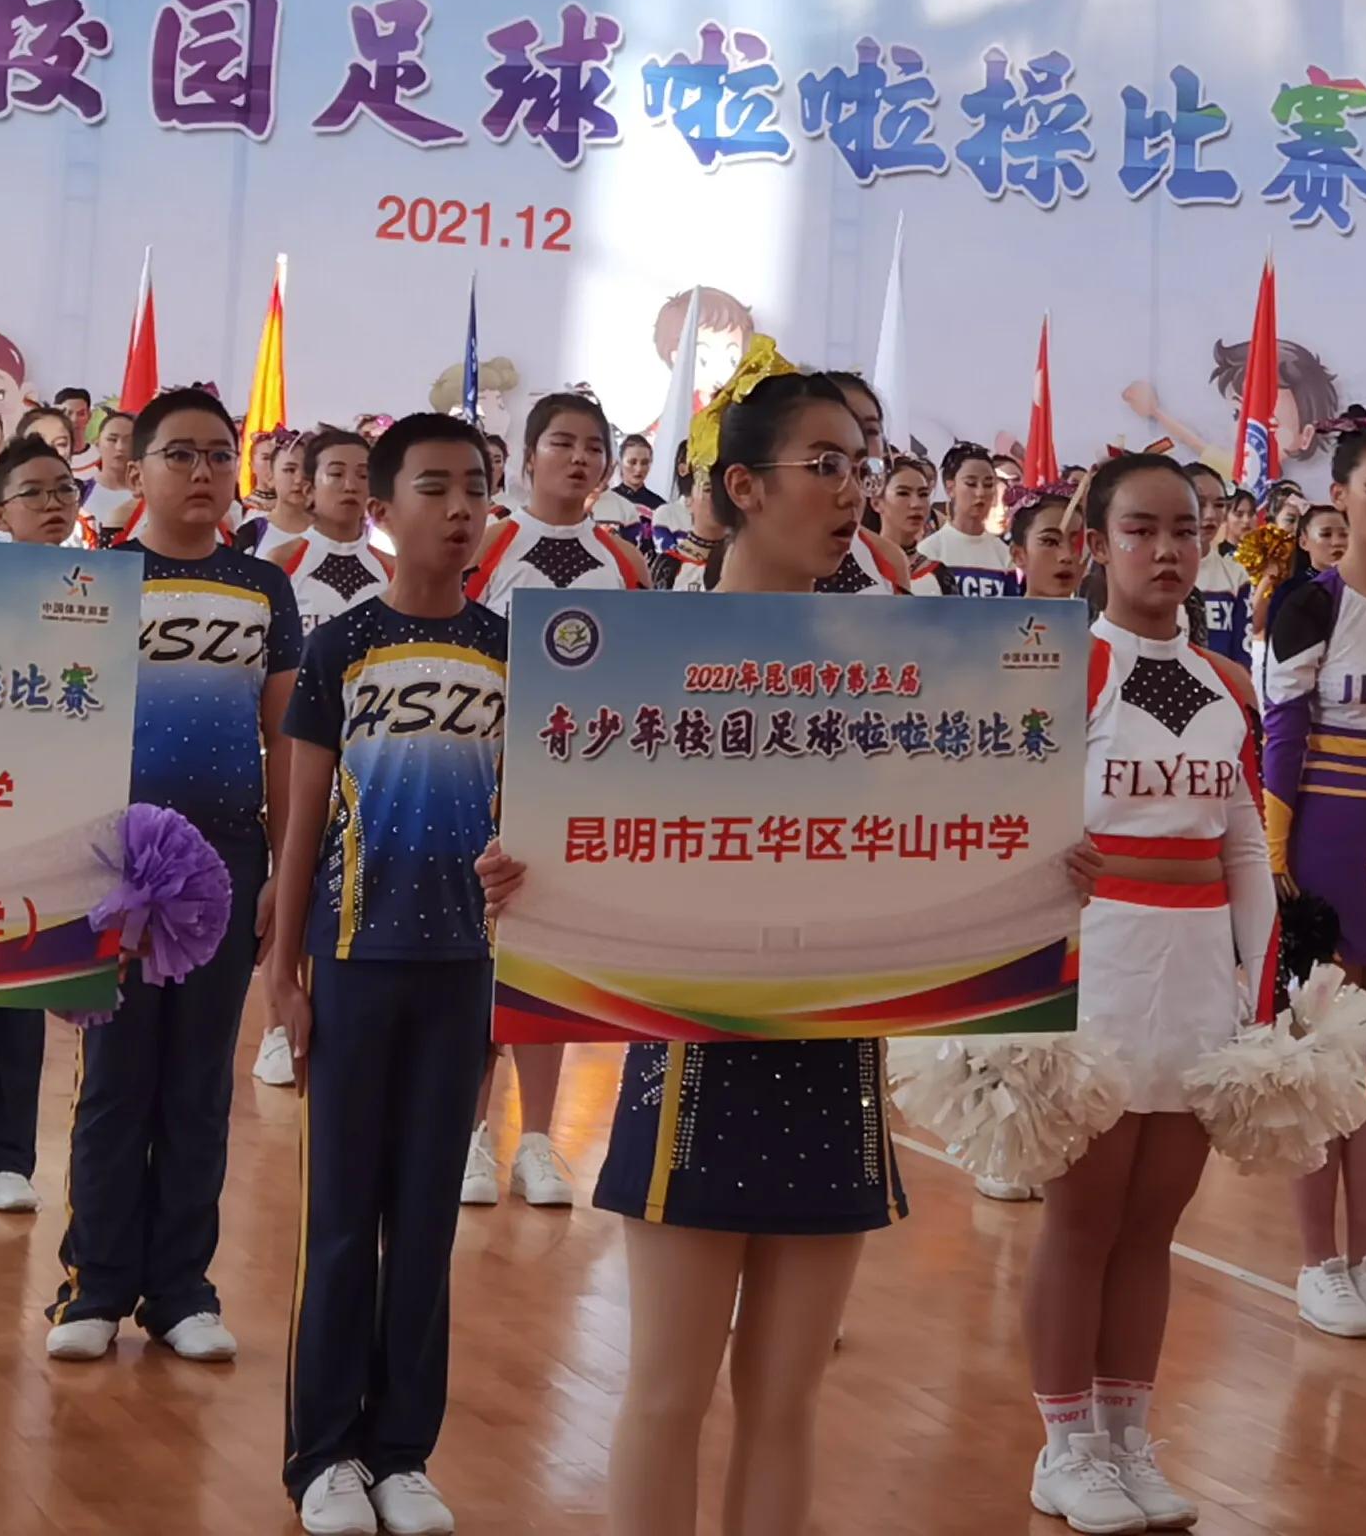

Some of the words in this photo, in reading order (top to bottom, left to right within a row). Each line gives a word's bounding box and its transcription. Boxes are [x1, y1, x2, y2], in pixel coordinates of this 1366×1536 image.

[375, 195, 572, 251] 2021.12
[684, 659, 922, 697] 2021年昆明市第五届
[539, 703, 1058, 762] 青少年校园足球啦啦操比赛
[564, 813, 1030, 864] 昆明市五华区华山中学
